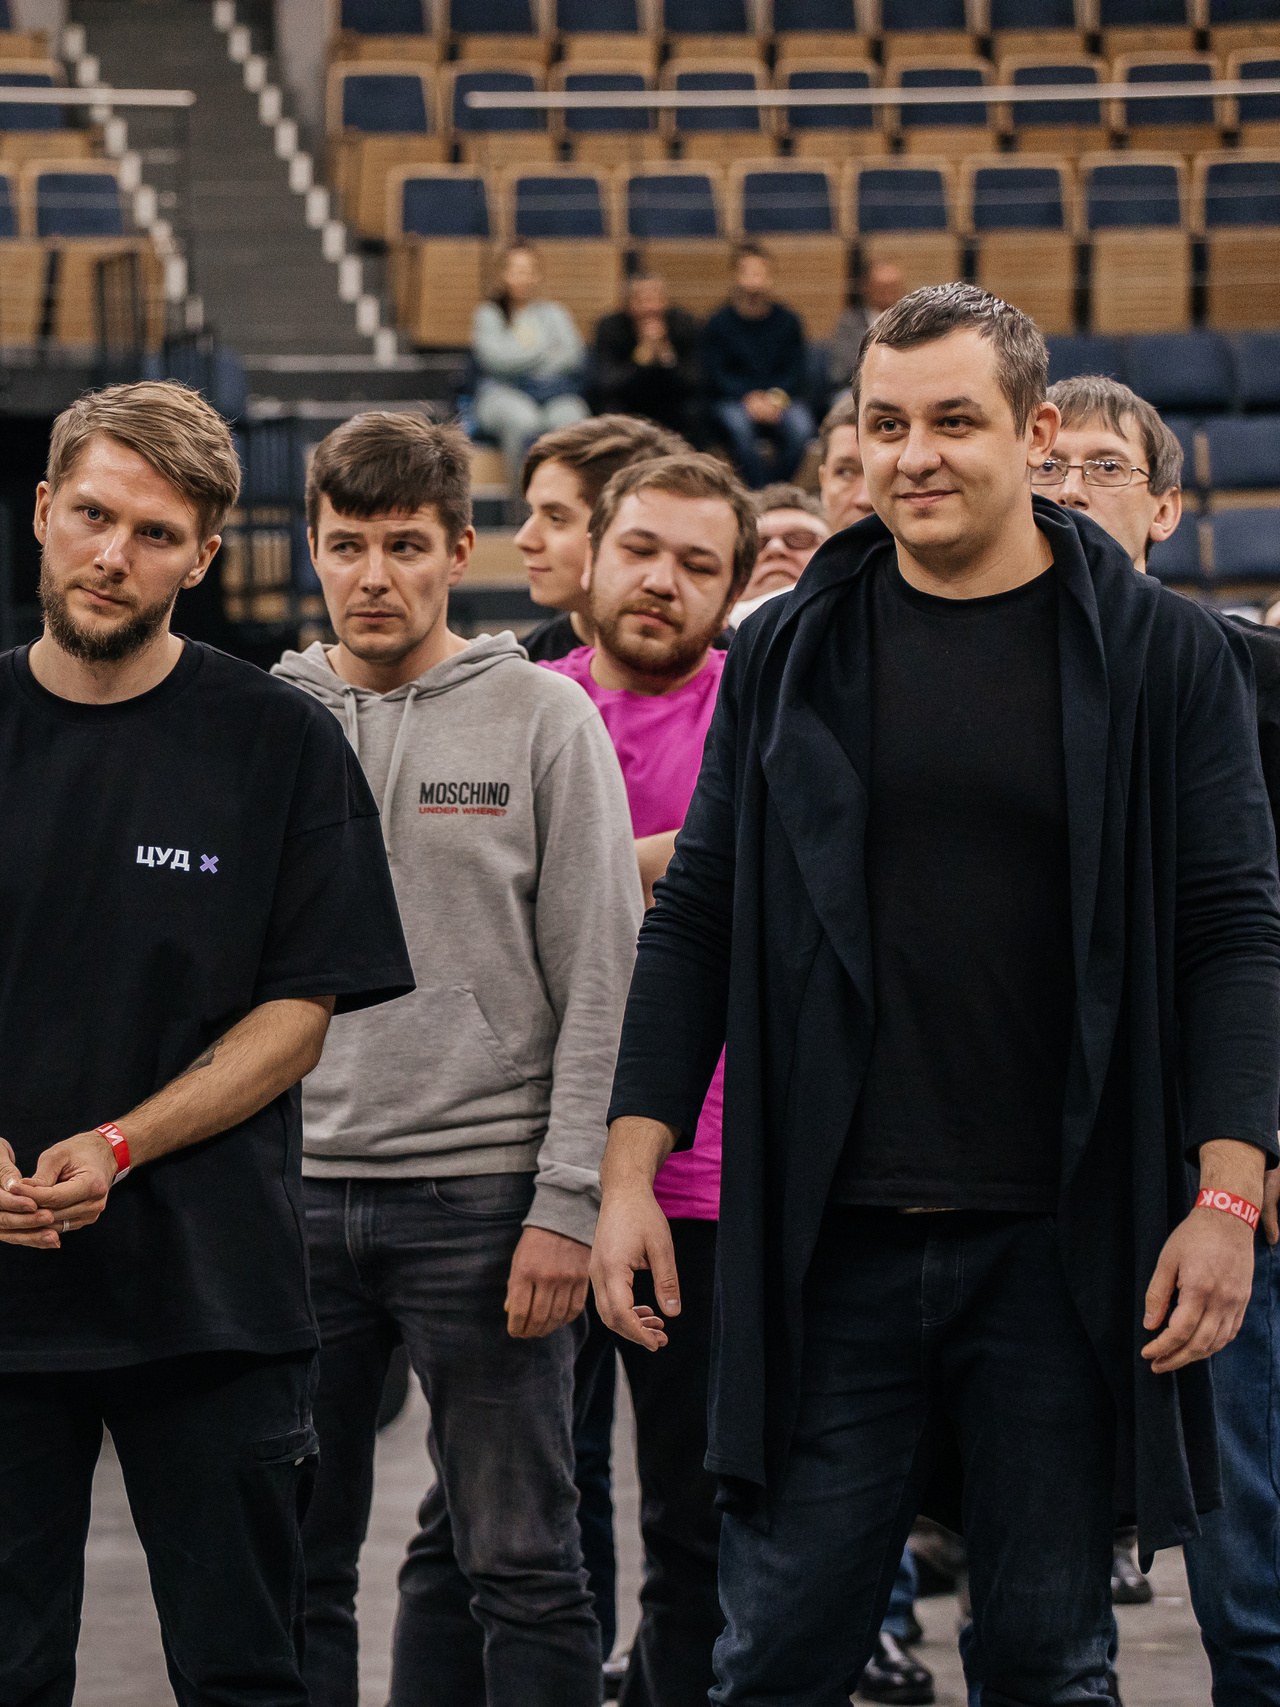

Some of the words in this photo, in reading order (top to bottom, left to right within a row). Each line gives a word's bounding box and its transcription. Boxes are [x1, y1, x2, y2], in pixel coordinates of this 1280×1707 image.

[419, 782, 510, 807] MOSCHINO
[418, 806, 459, 814] UNDER
[461, 807, 507, 817] WHERE?
[136, 845, 190, 872] ЦУД
[1199, 1190, 1259, 1228] ИГРОК
